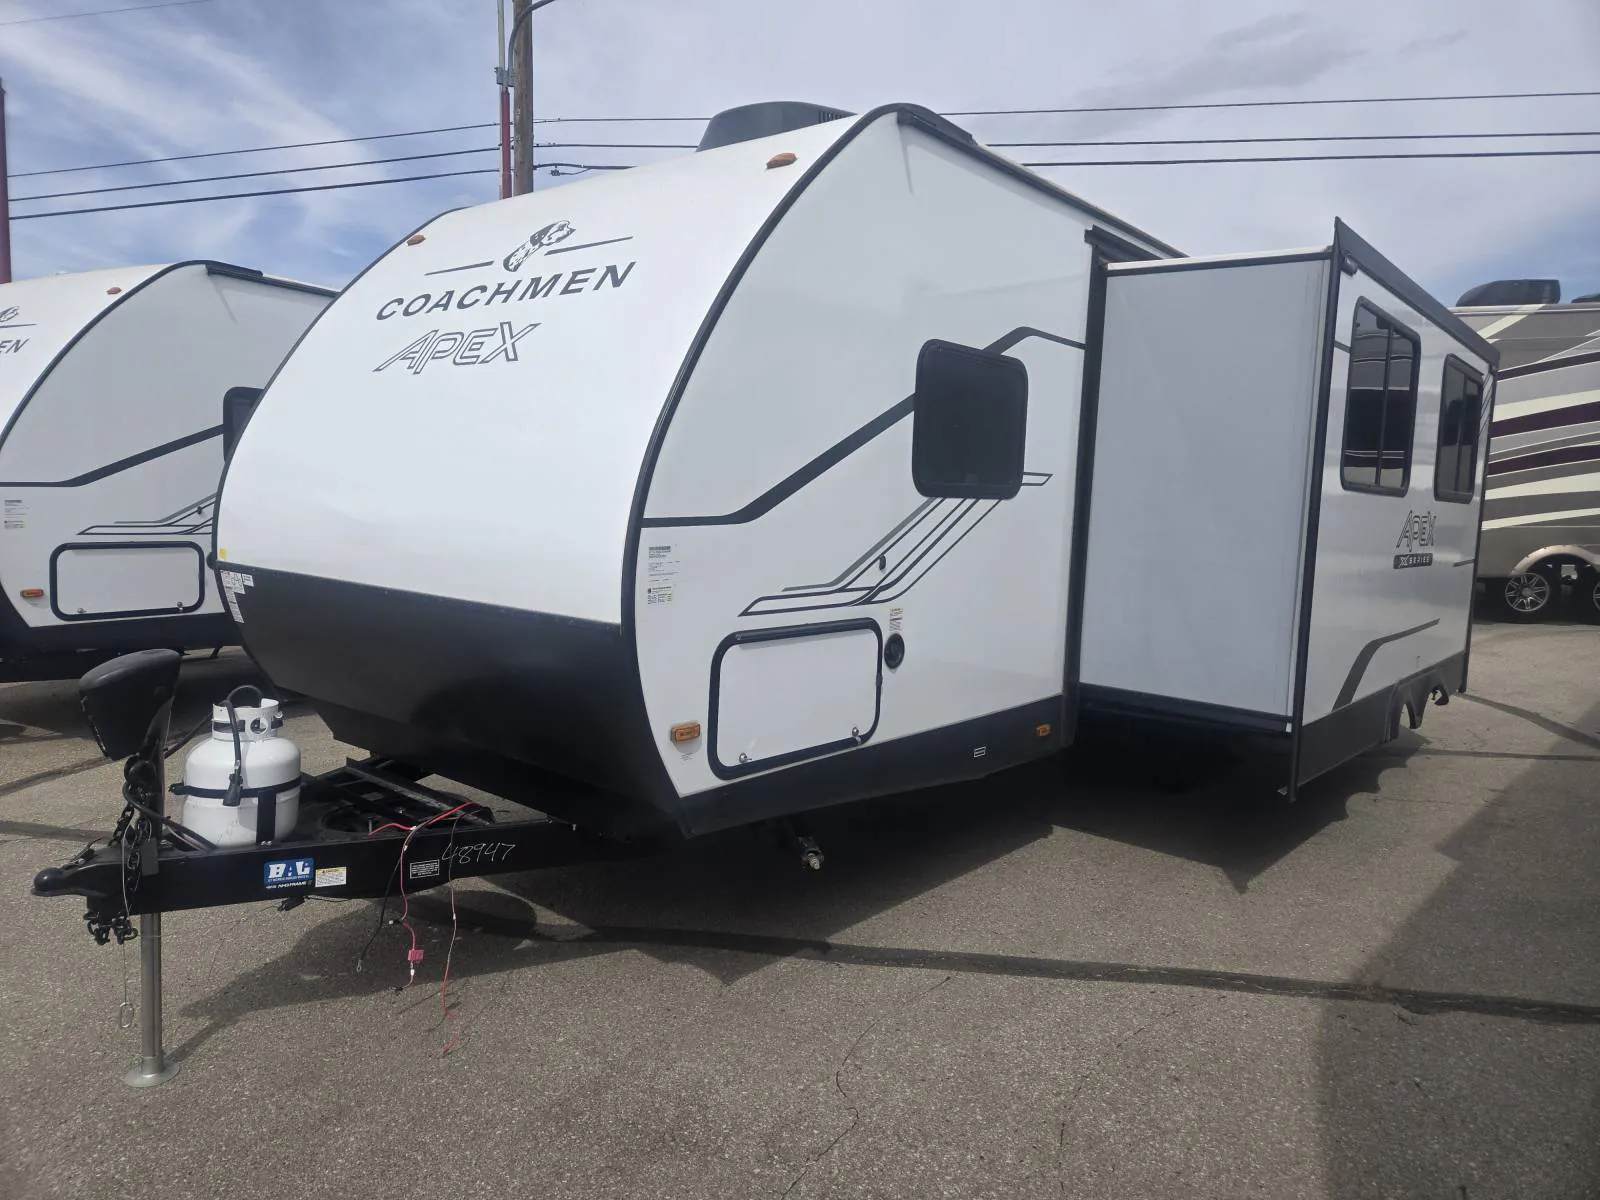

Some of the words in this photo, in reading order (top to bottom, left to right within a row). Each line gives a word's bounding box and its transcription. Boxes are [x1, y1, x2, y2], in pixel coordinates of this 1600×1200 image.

[376, 261, 636, 321] COACHMEN
[372, 321, 542, 375] APEX
[1396, 510, 1437, 552] APEX
[441, 842, 516, 864] 48947
